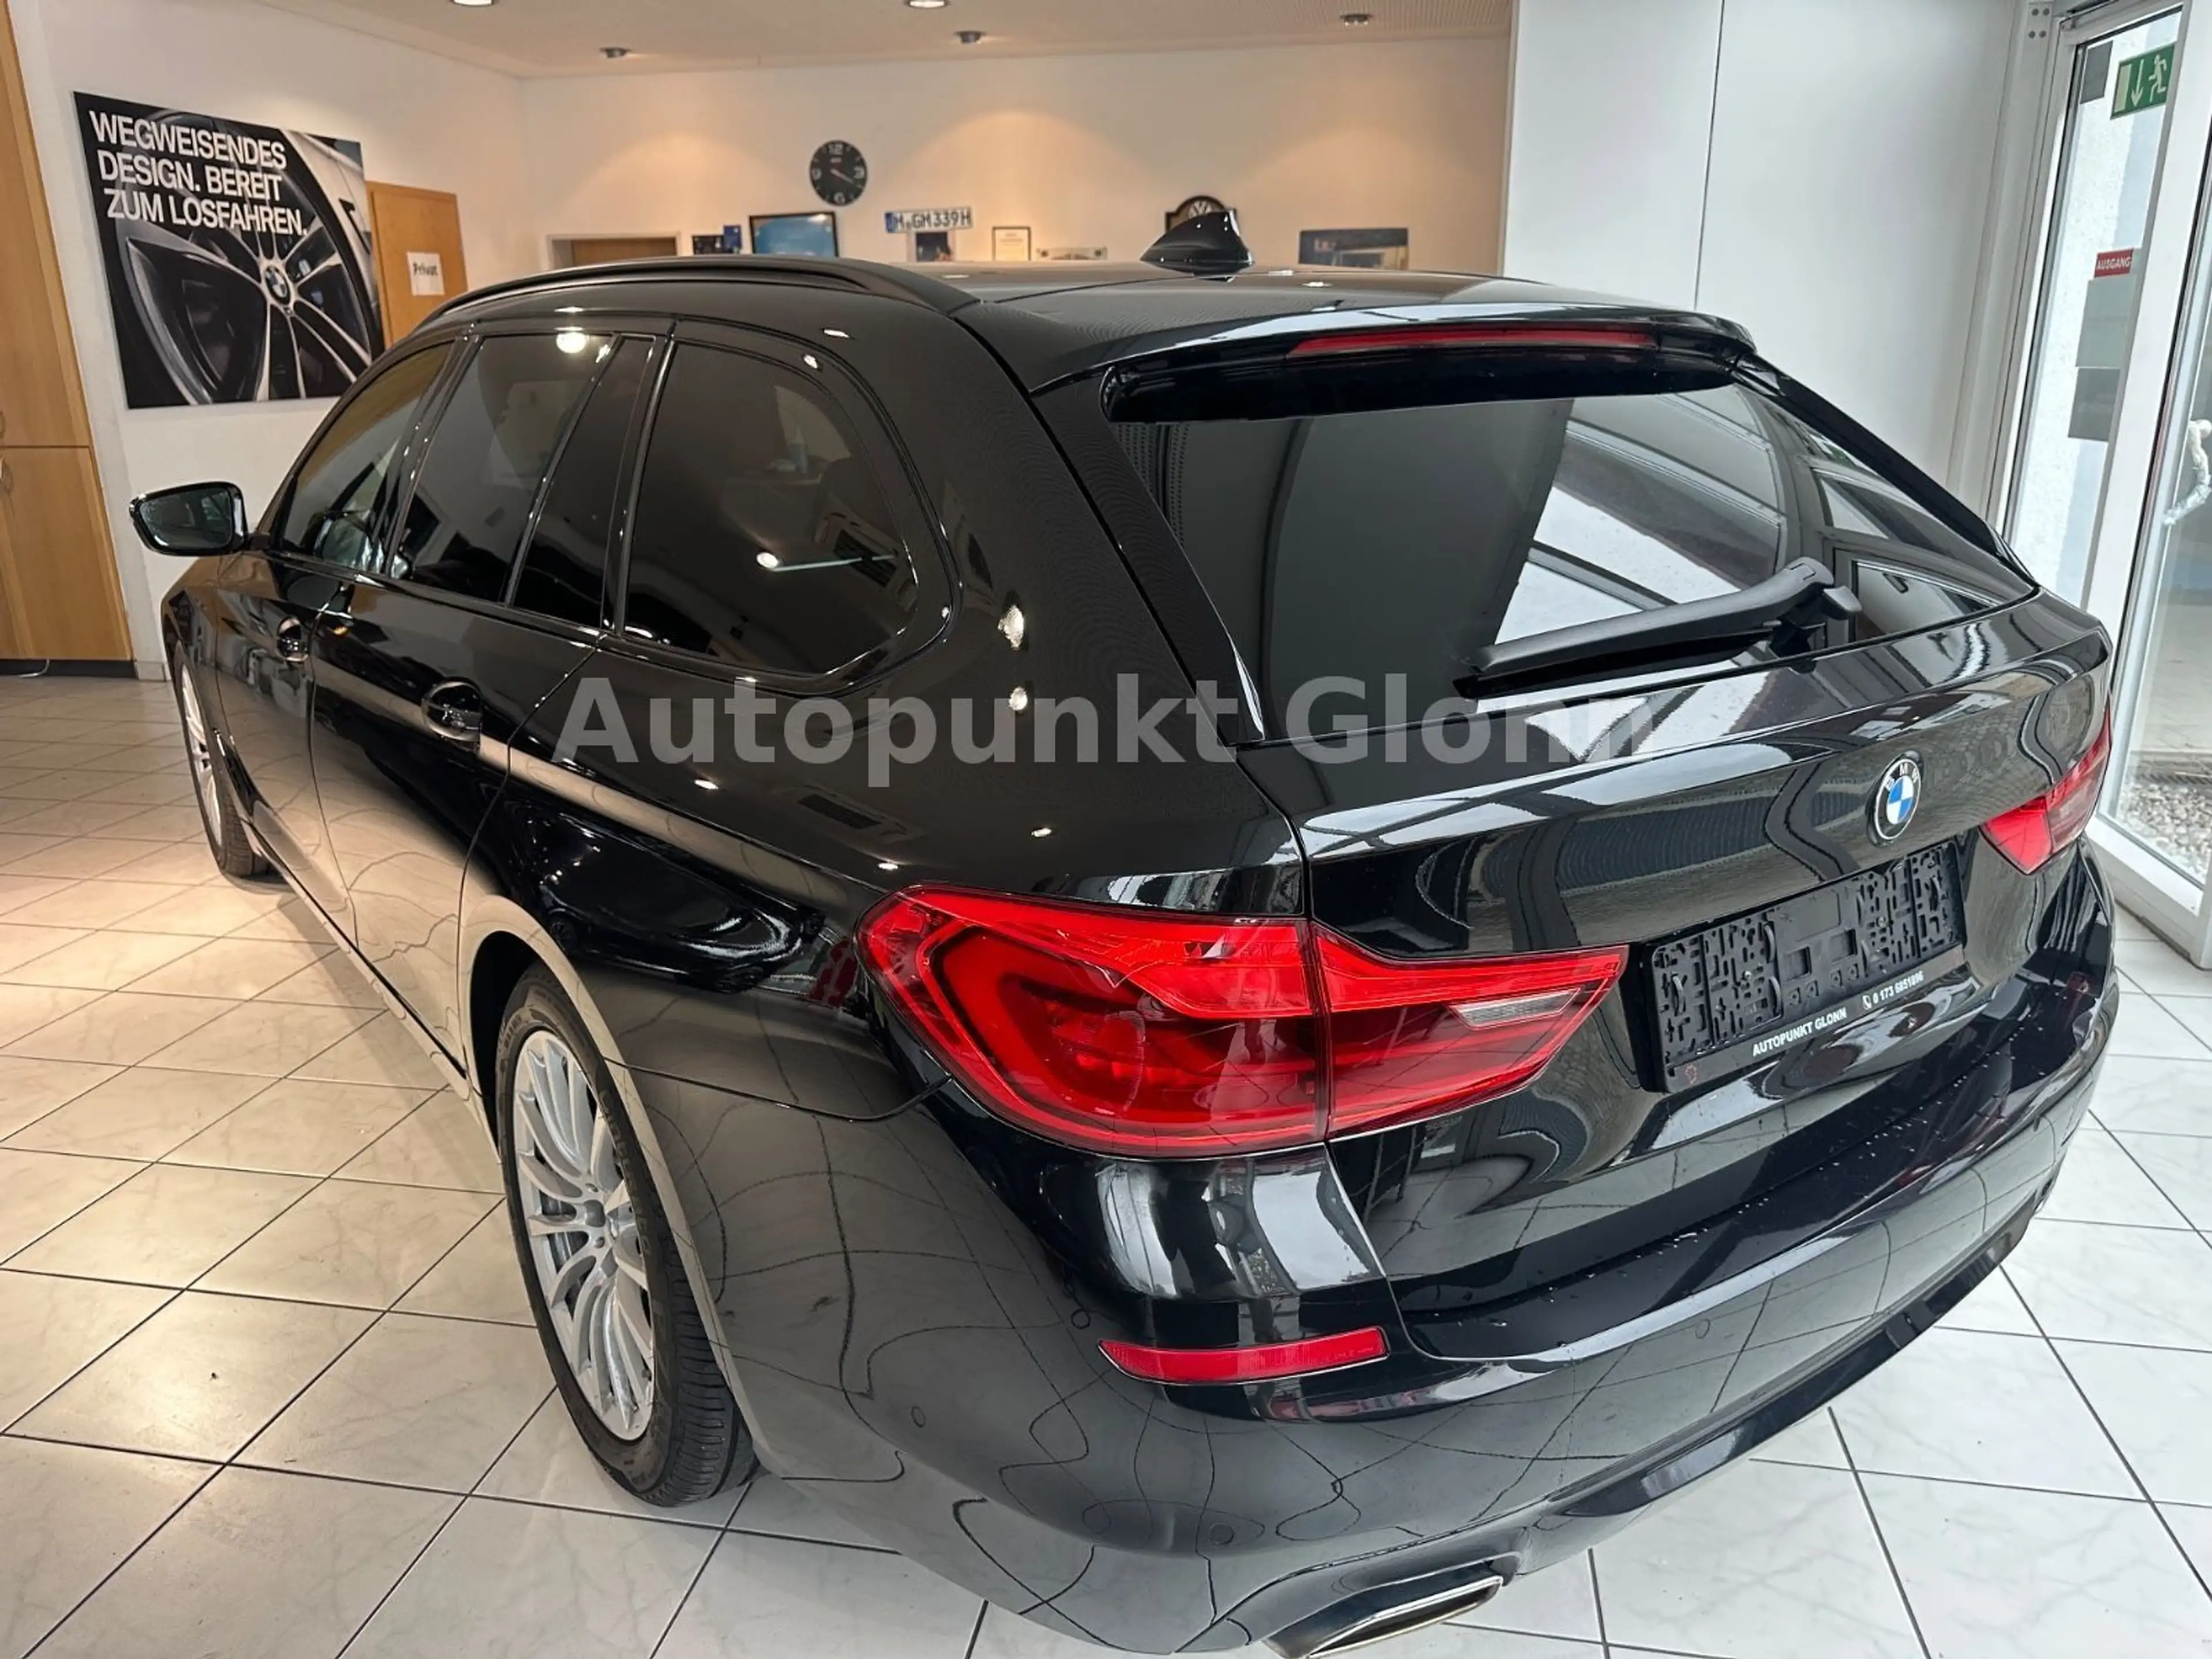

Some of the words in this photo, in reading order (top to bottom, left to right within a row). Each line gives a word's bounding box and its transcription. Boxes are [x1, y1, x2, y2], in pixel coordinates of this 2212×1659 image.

[89, 111, 287, 171] WEGWEISENDES
[97, 150, 200, 192] DESIGN.
[205, 164, 282, 202] BEREIT
[104, 188, 164, 223] ZUM
[169, 195, 307, 236] LOSFAHREN.
[2097, 256, 2131, 270] AUSGANG
[1752, 1021, 1813, 1057] AUTOPUNKT
[1815, 1007, 1848, 1031] GLONN
